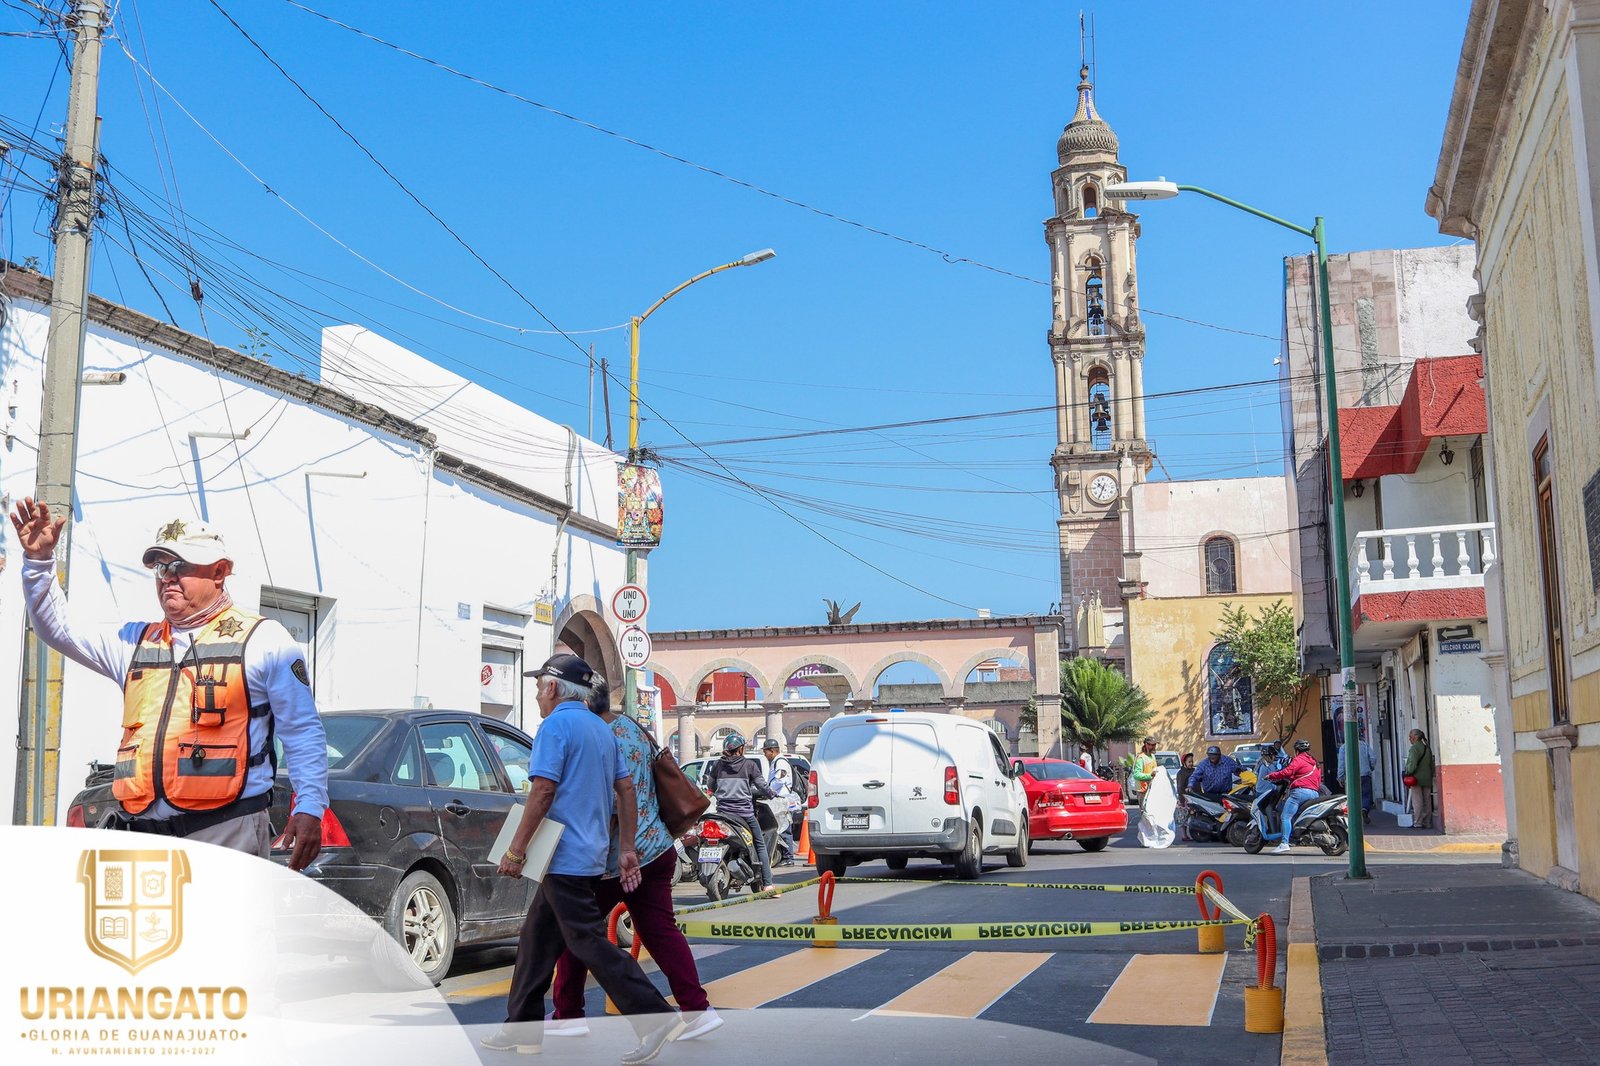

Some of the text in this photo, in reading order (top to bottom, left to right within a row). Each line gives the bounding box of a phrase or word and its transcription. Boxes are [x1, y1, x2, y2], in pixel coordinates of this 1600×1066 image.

[623, 590, 637, 600] UNO
[627, 600, 632, 609] Y
[622, 609, 636, 619] UNO
[627, 635, 643, 643] uno
[632, 643, 638, 651] y
